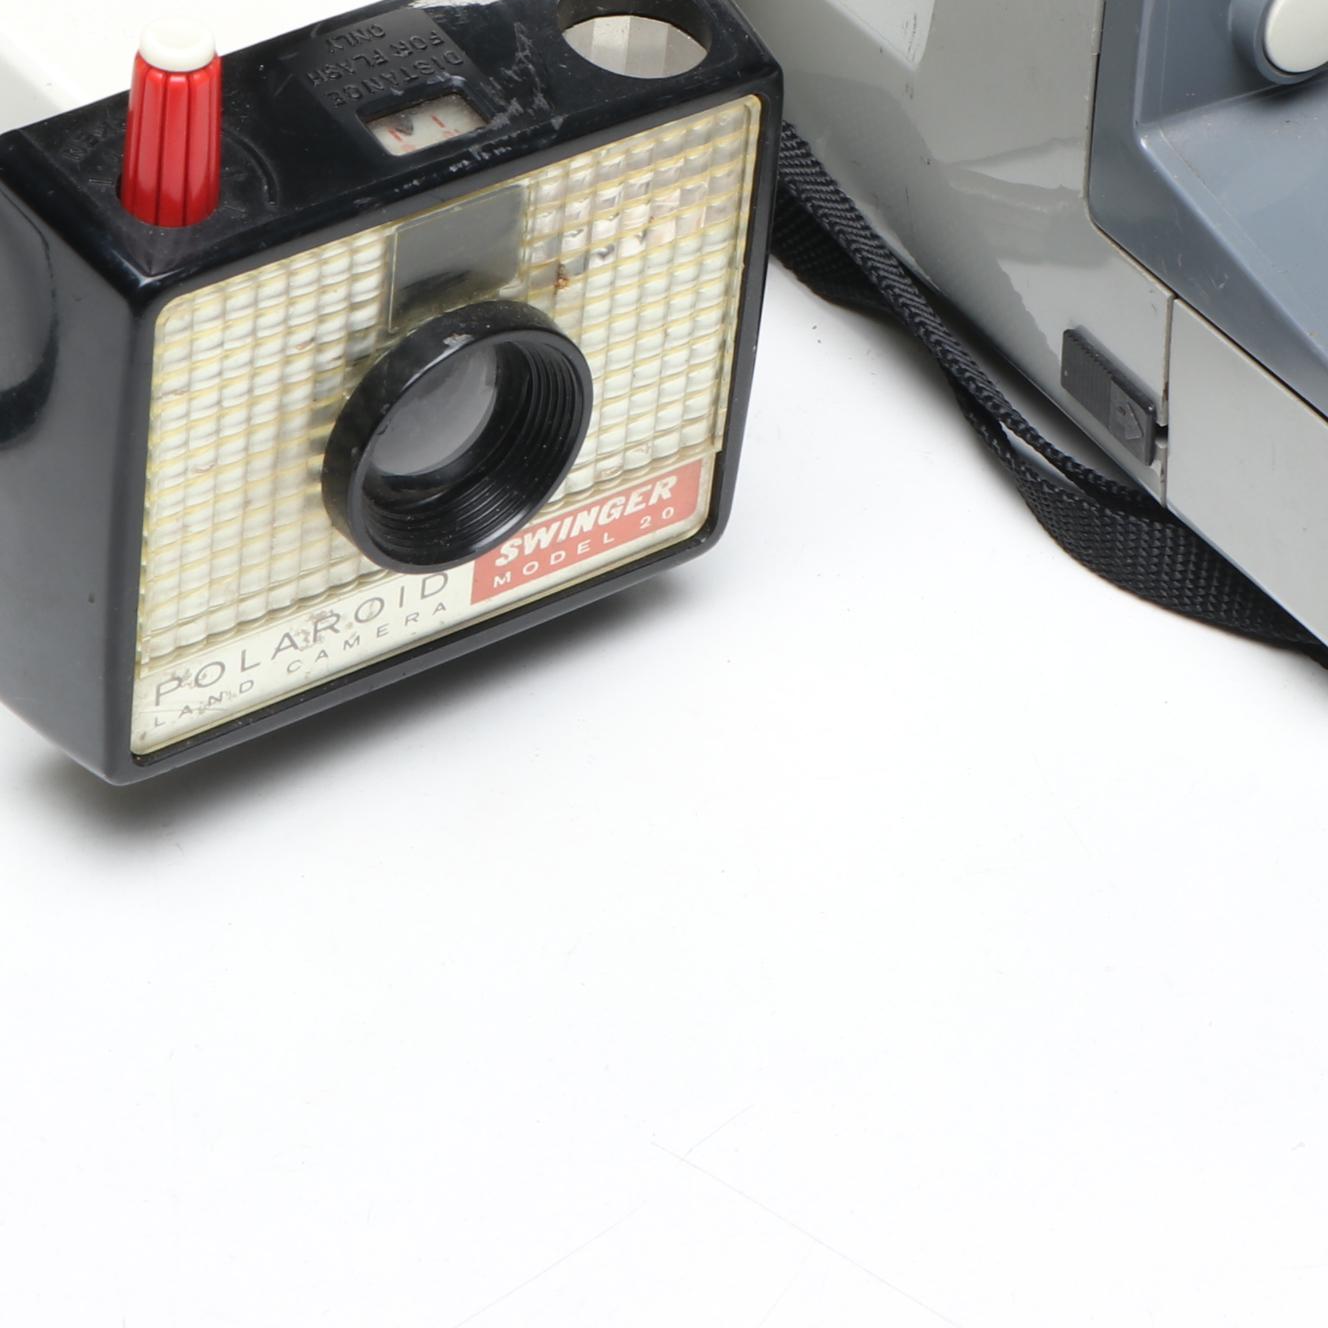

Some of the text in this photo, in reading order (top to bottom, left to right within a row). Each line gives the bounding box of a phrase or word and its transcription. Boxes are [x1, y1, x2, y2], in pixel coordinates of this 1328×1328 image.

[306, 30, 445, 87] FOR FLASH
[326, 23, 386, 51] ONLY
[327, 49, 464, 108] DISTANCE
[492, 506, 676, 589] MODEL 20
[494, 475, 678, 567] SWINGER
[153, 601, 448, 728] LAND CAMERA
[154, 570, 449, 708] POLAROID
